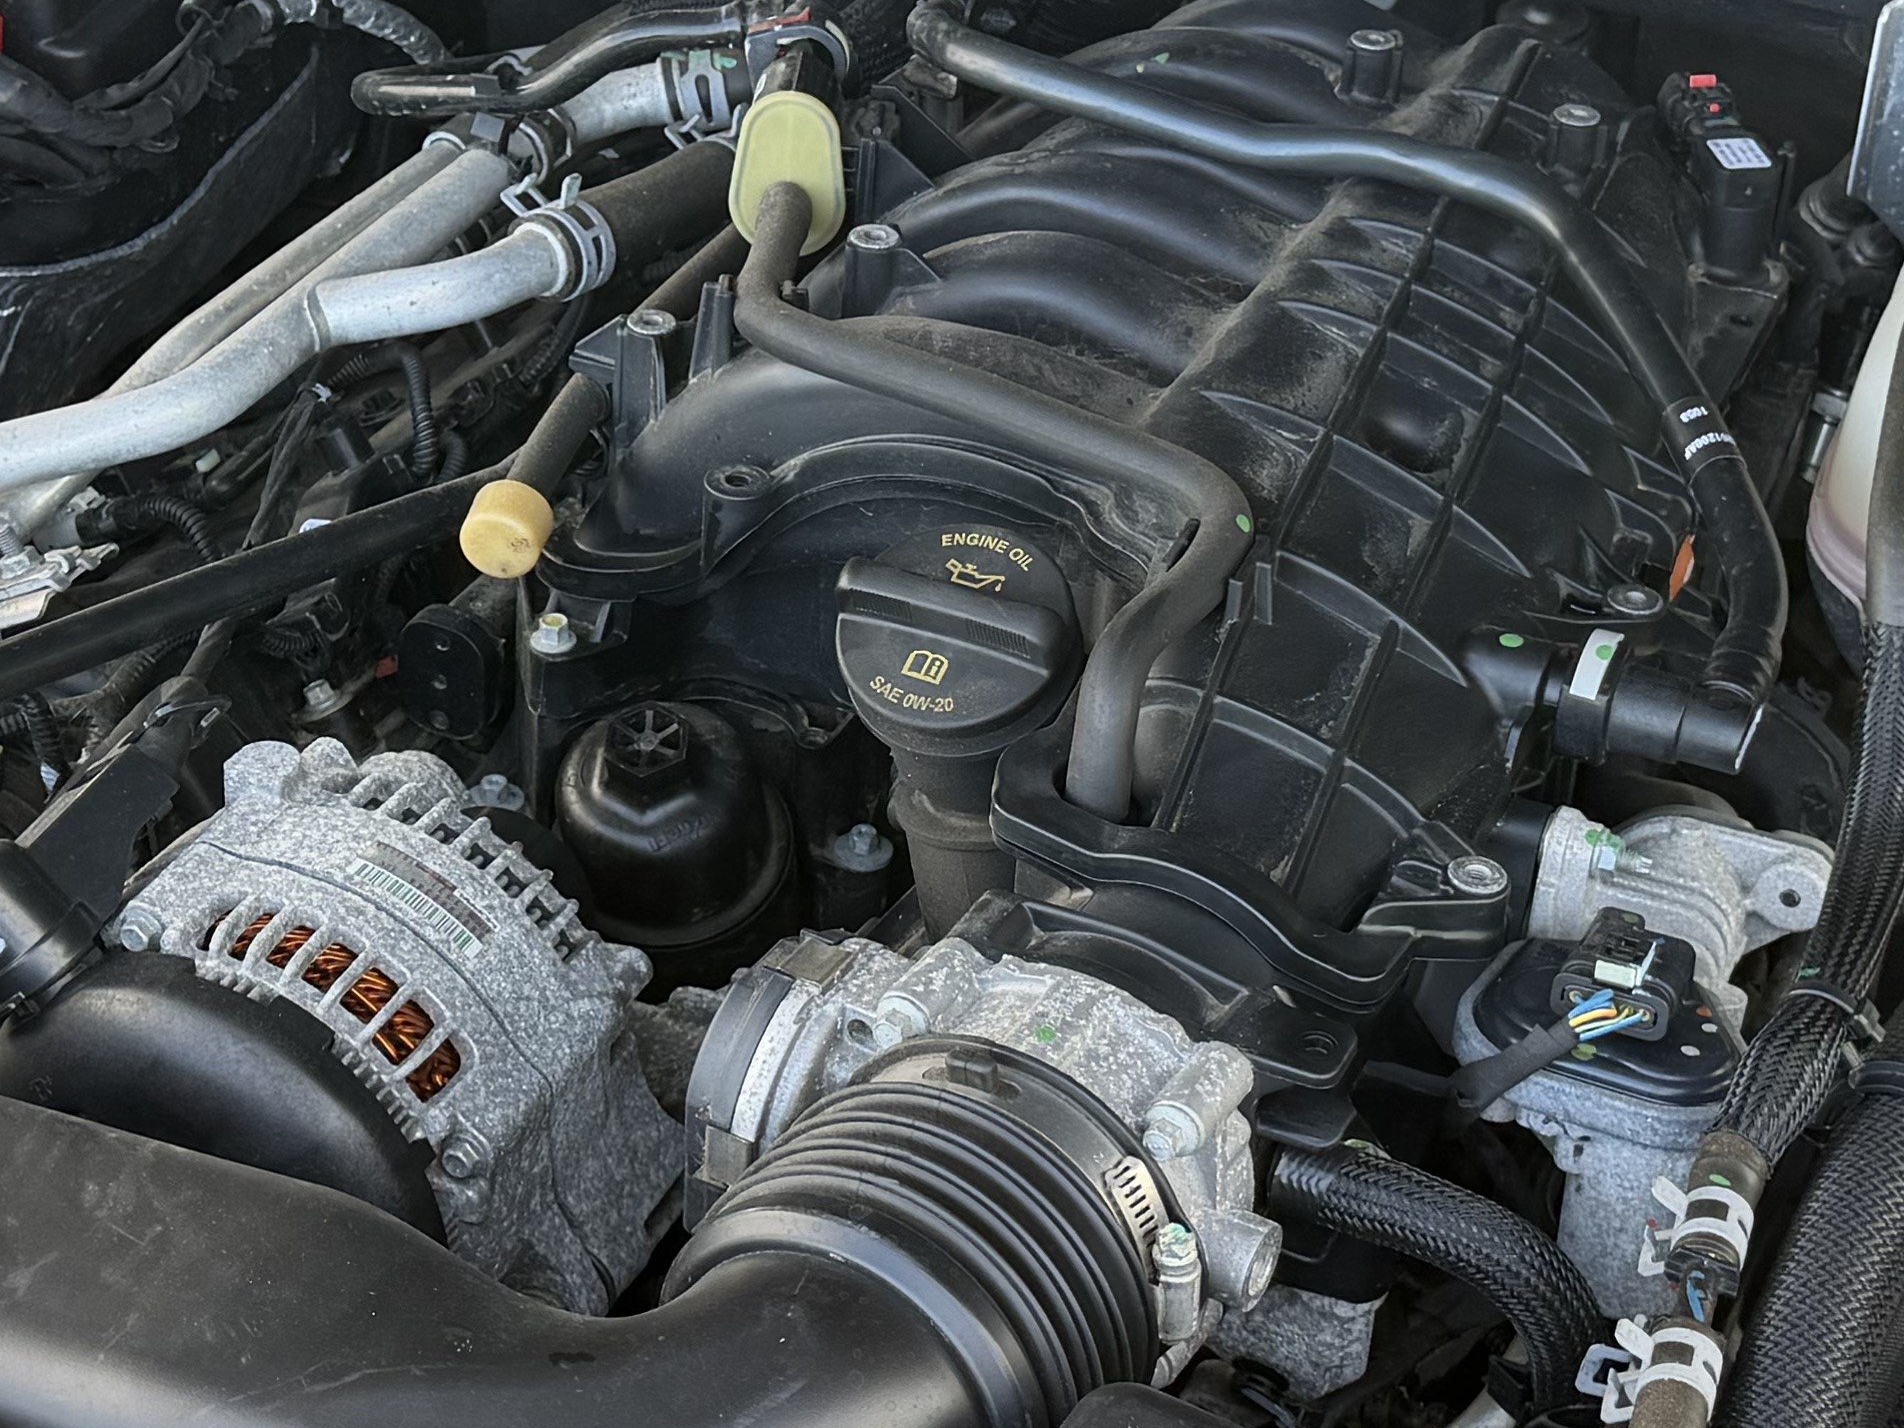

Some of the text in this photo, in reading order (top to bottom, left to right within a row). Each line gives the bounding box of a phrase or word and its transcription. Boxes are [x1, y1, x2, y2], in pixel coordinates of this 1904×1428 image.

[941, 532, 1034, 572] ENGINE OIL
[870, 675, 954, 713] SAE 0W-20
